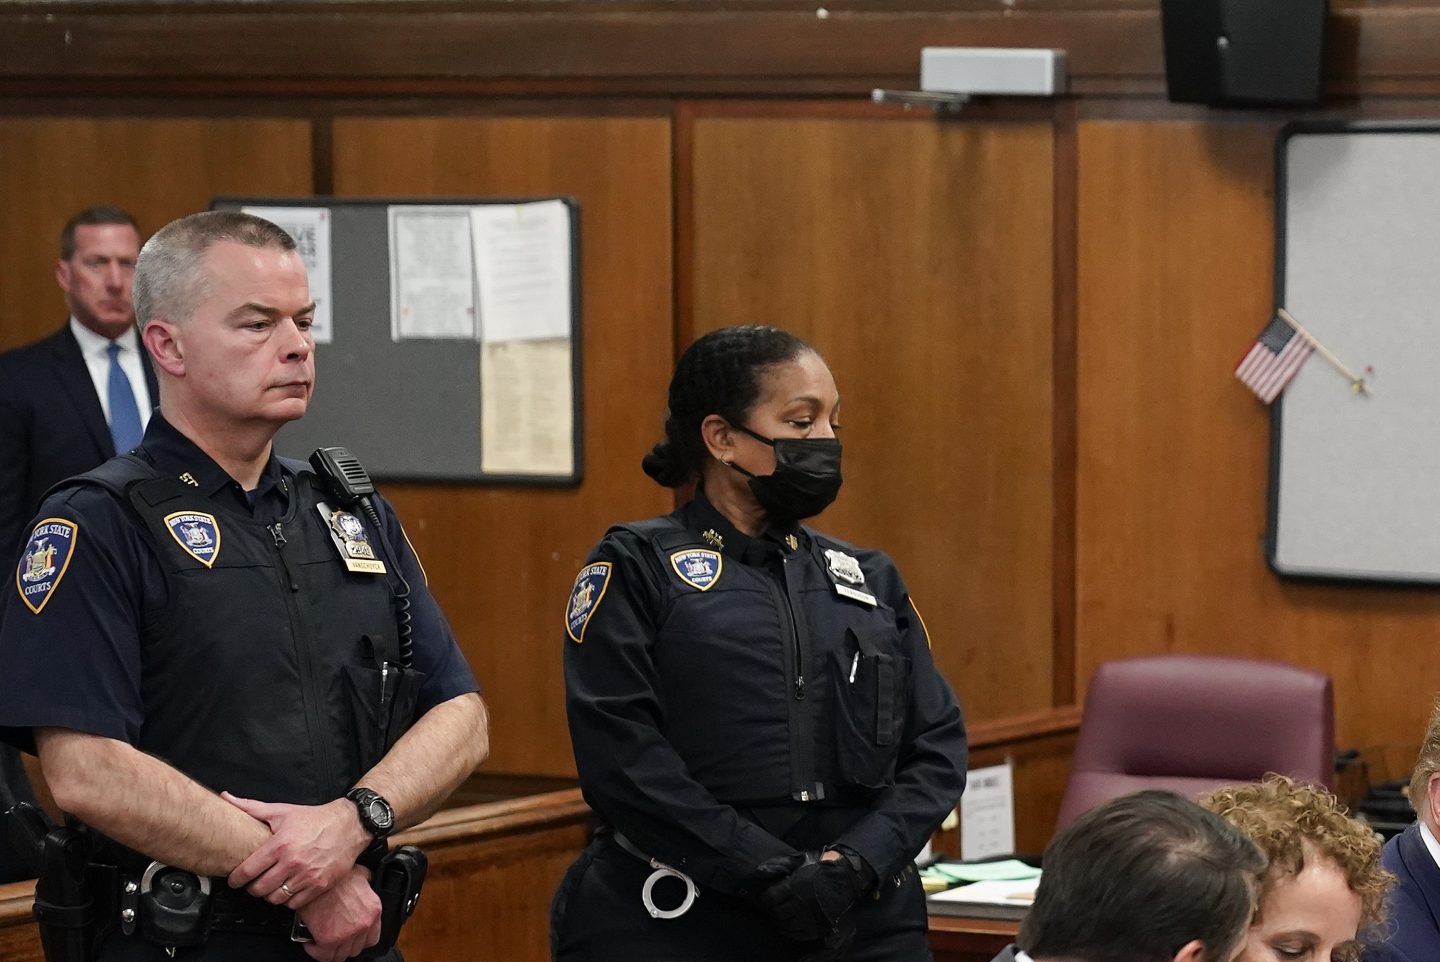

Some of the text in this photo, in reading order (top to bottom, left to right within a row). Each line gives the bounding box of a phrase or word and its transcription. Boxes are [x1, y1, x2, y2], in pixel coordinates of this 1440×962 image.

[48, 524, 71, 538] STATE
[590, 566, 608, 576] STATE
[25, 581, 51, 596] COURTS
